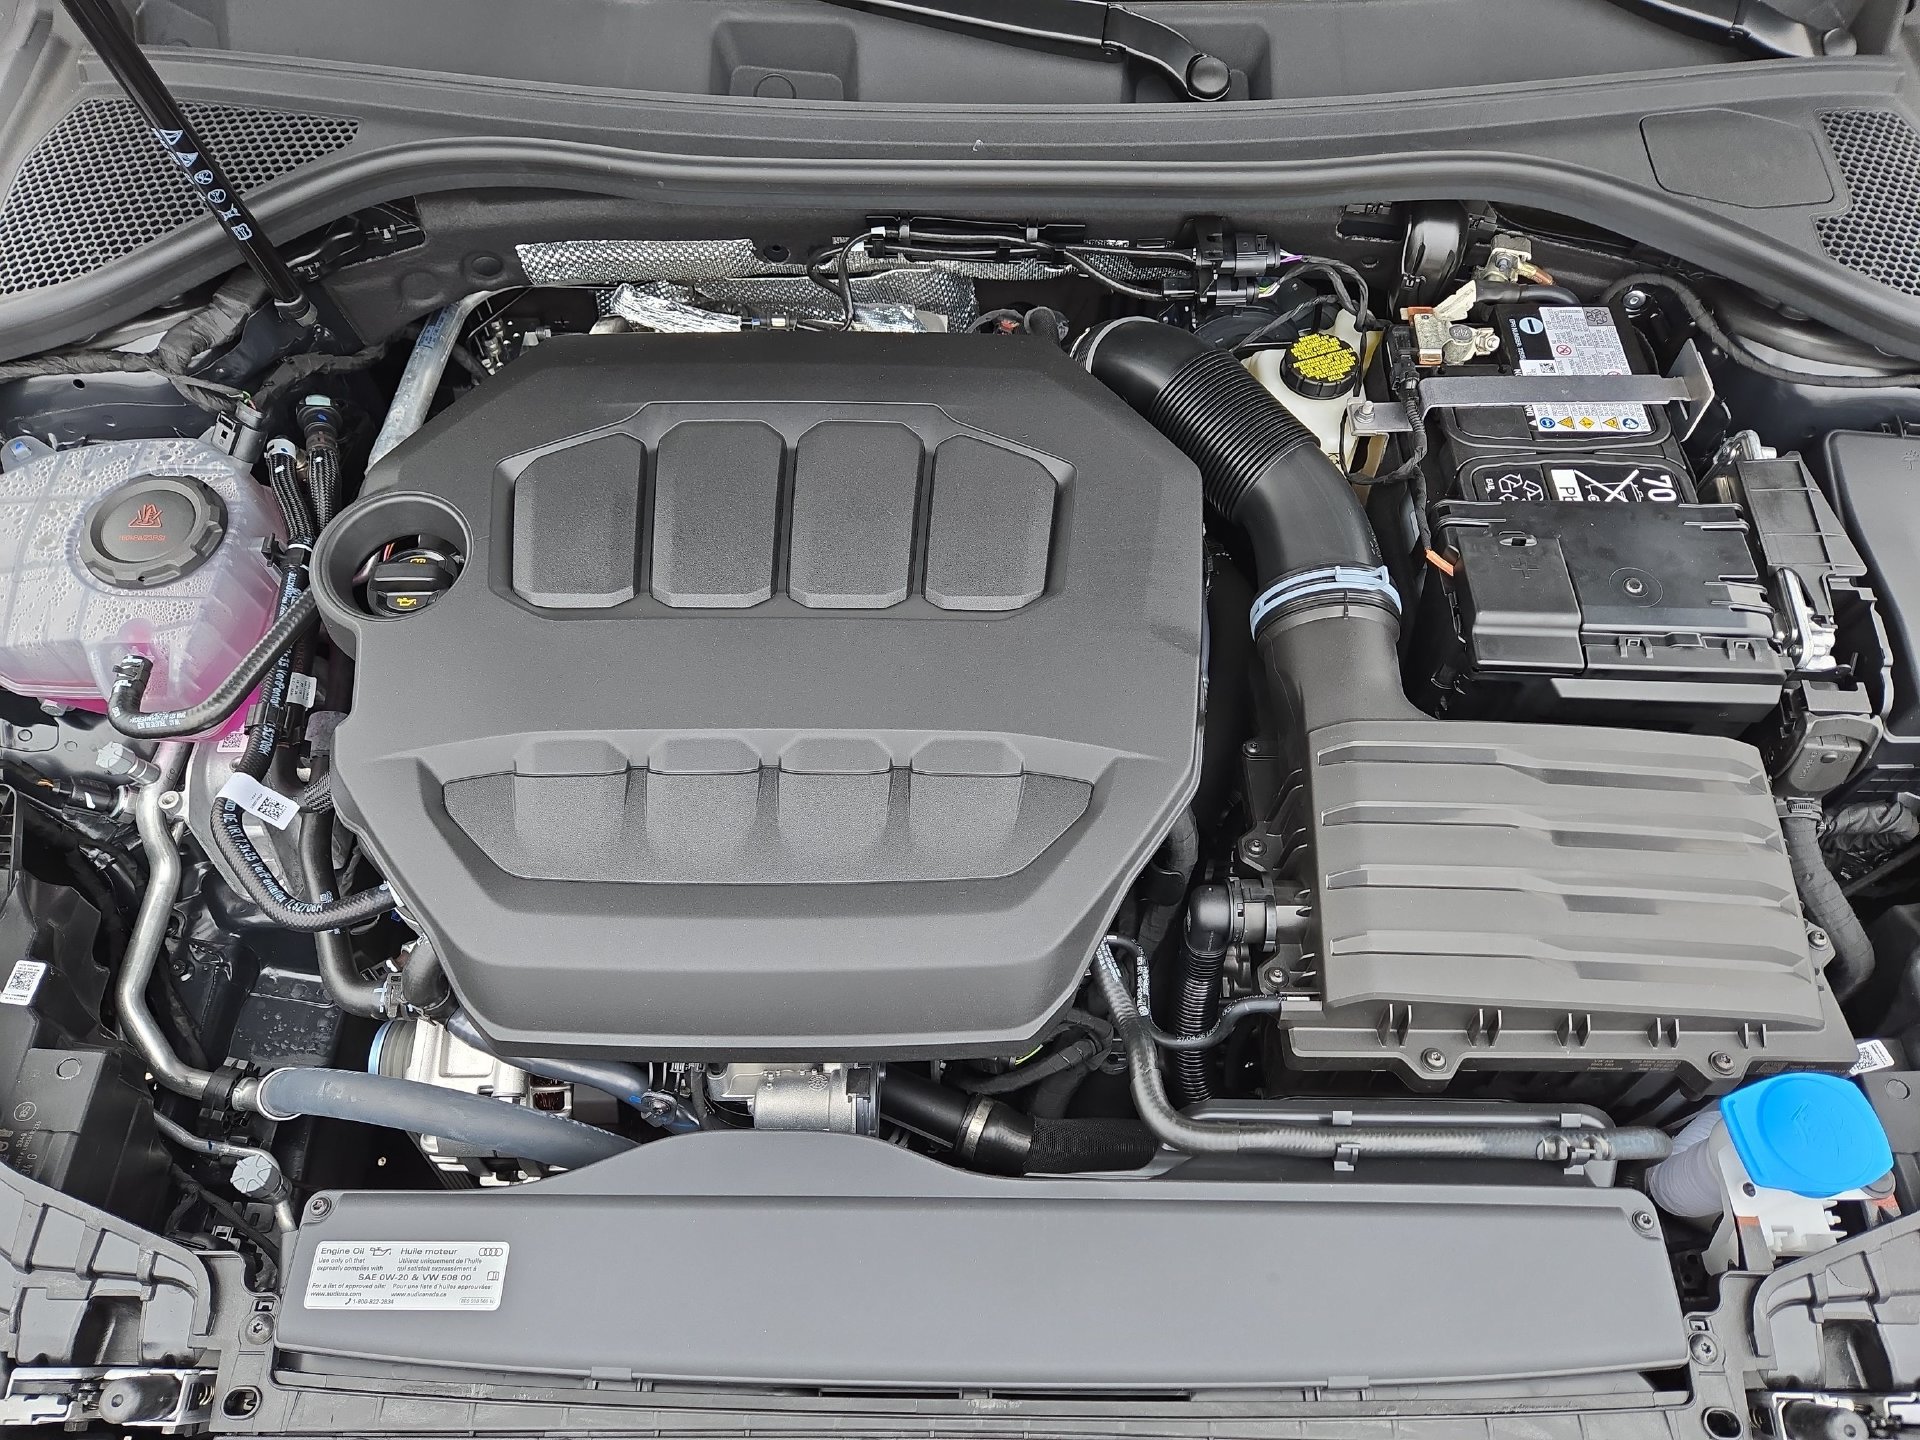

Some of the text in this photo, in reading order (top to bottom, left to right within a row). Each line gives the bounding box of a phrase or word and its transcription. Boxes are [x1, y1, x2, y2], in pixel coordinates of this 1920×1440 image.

[1642, 475, 1677, 502] 70
[320, 1247, 365, 1256] Engine Oil
[400, 1247, 422, 1255] Huile
[358, 1273, 377, 1281] SAE
[379, 1273, 409, 1281] 0W-20
[411, 1273, 419, 1281] &
[422, 1273, 440, 1281] VW
